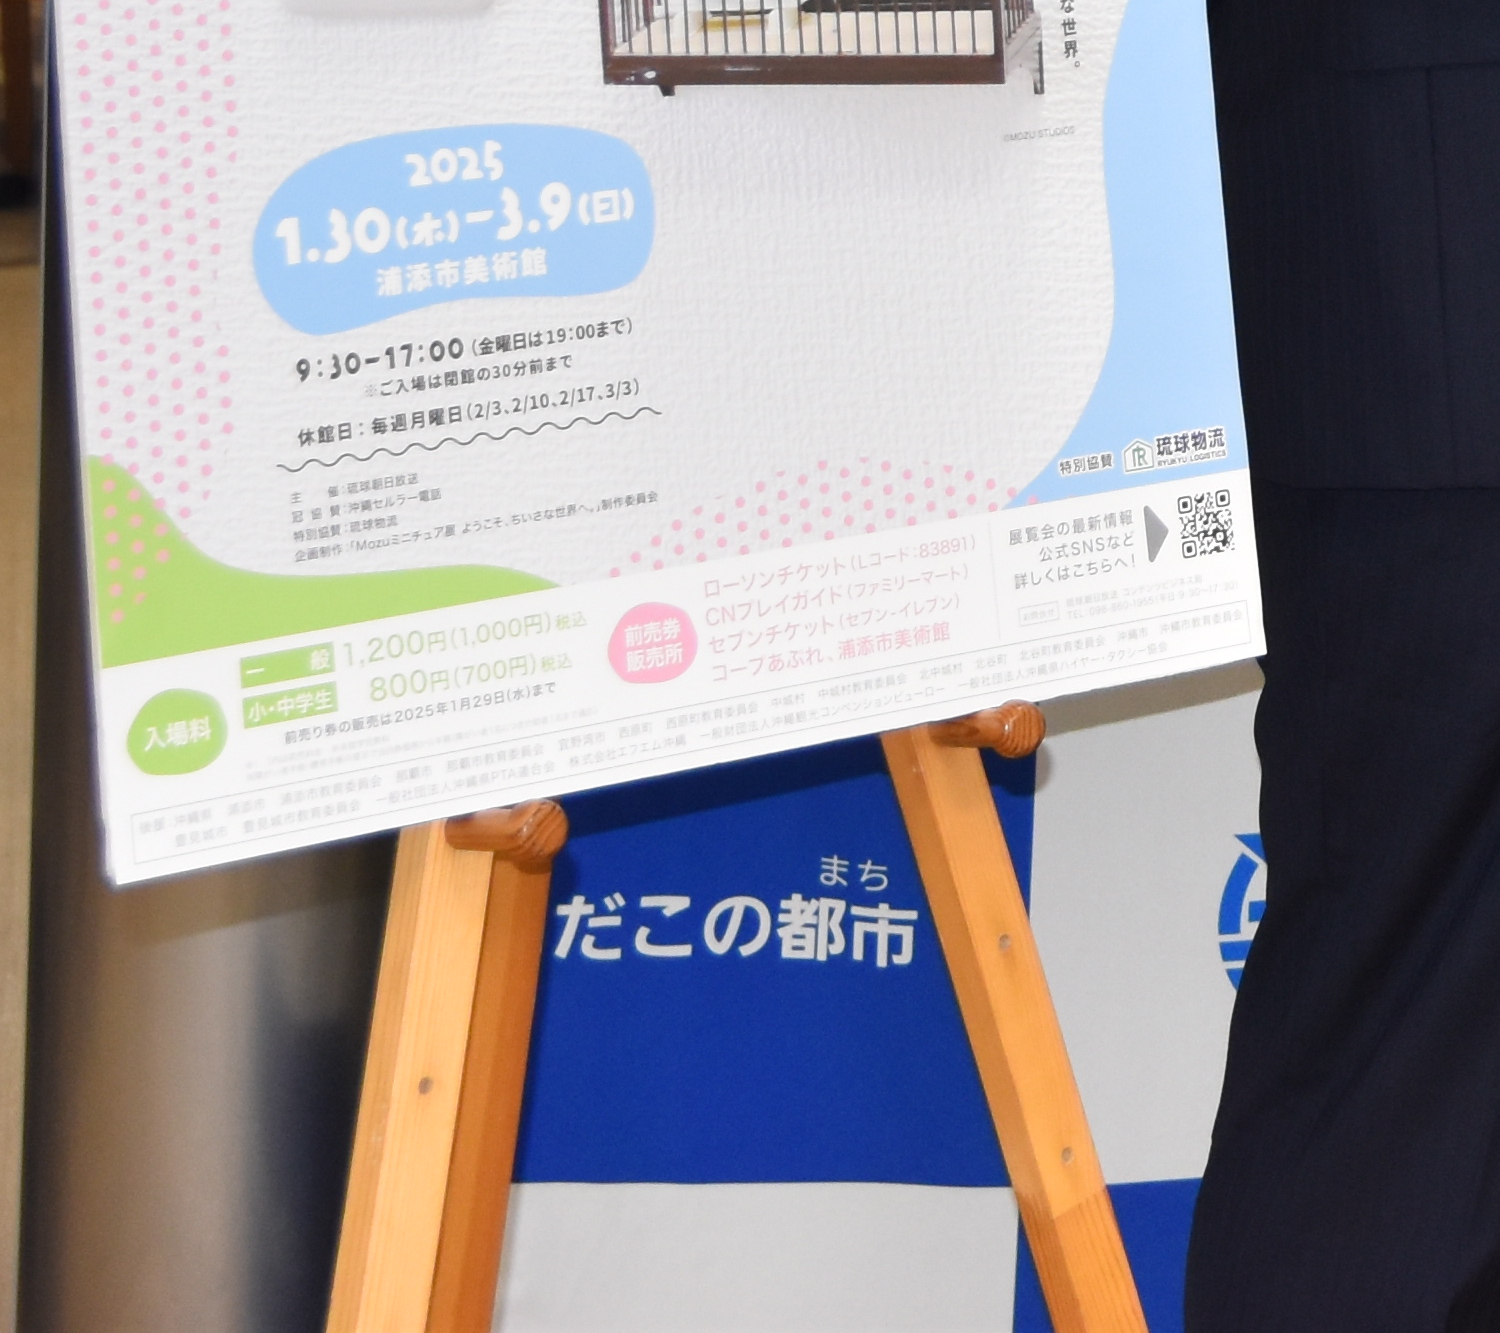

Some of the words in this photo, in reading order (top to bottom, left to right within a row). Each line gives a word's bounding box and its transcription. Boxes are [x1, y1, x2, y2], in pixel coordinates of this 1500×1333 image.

[405, 141, 505, 187] 2025
[376, 247, 548, 297] 浦添市美術館
[1060, 453, 1114, 474] 特別協賛
[1155, 428, 1226, 457] 琉球物流
[1009, 510, 1134, 546] 展覧会の最新情報
[1039, 530, 1135, 562] 公式SNSなど
[624, 617, 681, 648] 前売券
[626, 643, 684, 673] 販売所
[145, 716, 212, 751] 入場料
[819, 855, 889, 891] まち
[554, 894, 917, 967] だこの都市
